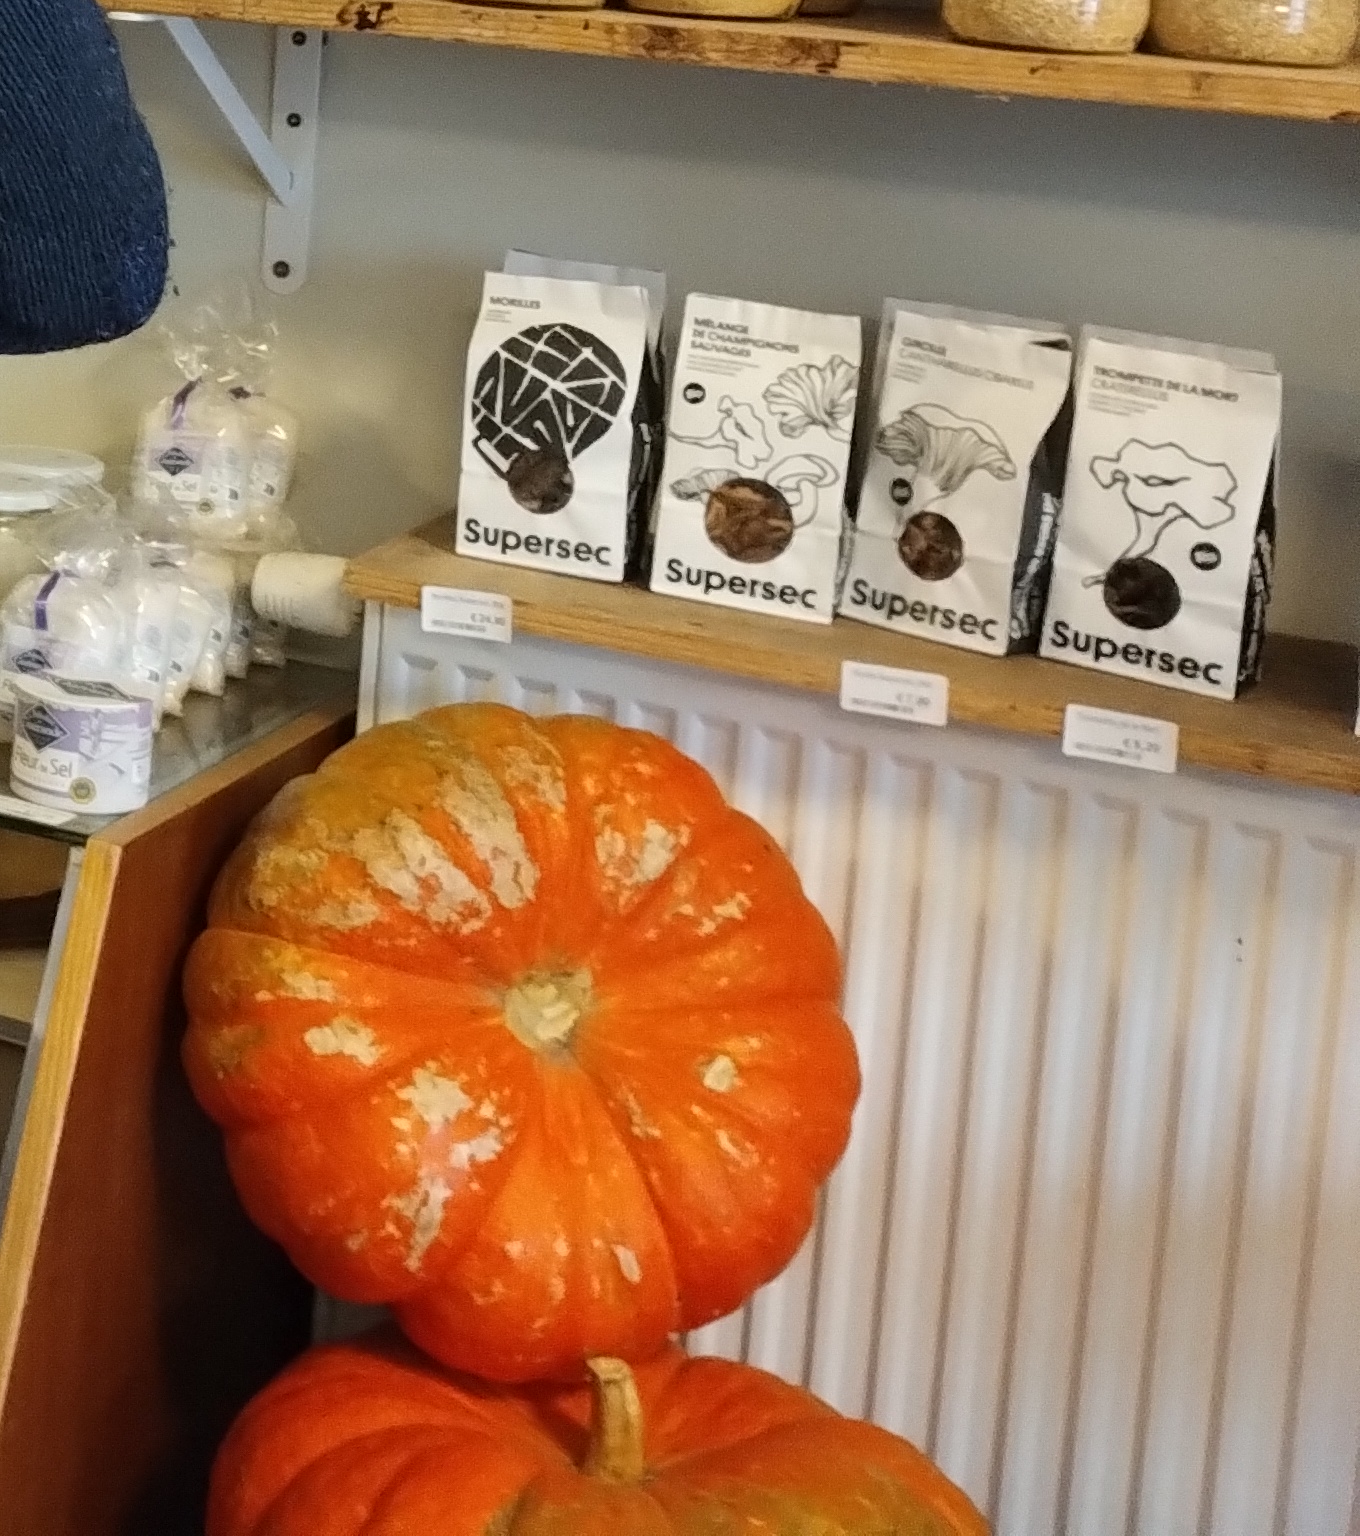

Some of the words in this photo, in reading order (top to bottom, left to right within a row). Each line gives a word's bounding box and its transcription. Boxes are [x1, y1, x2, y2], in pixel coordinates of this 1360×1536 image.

[463, 517, 612, 566] Supersec
[665, 558, 819, 610] Supersec
[850, 578, 1000, 641] Supersec
[1049, 620, 1224, 686] Supersec
[50, 757, 73, 778] Sel
